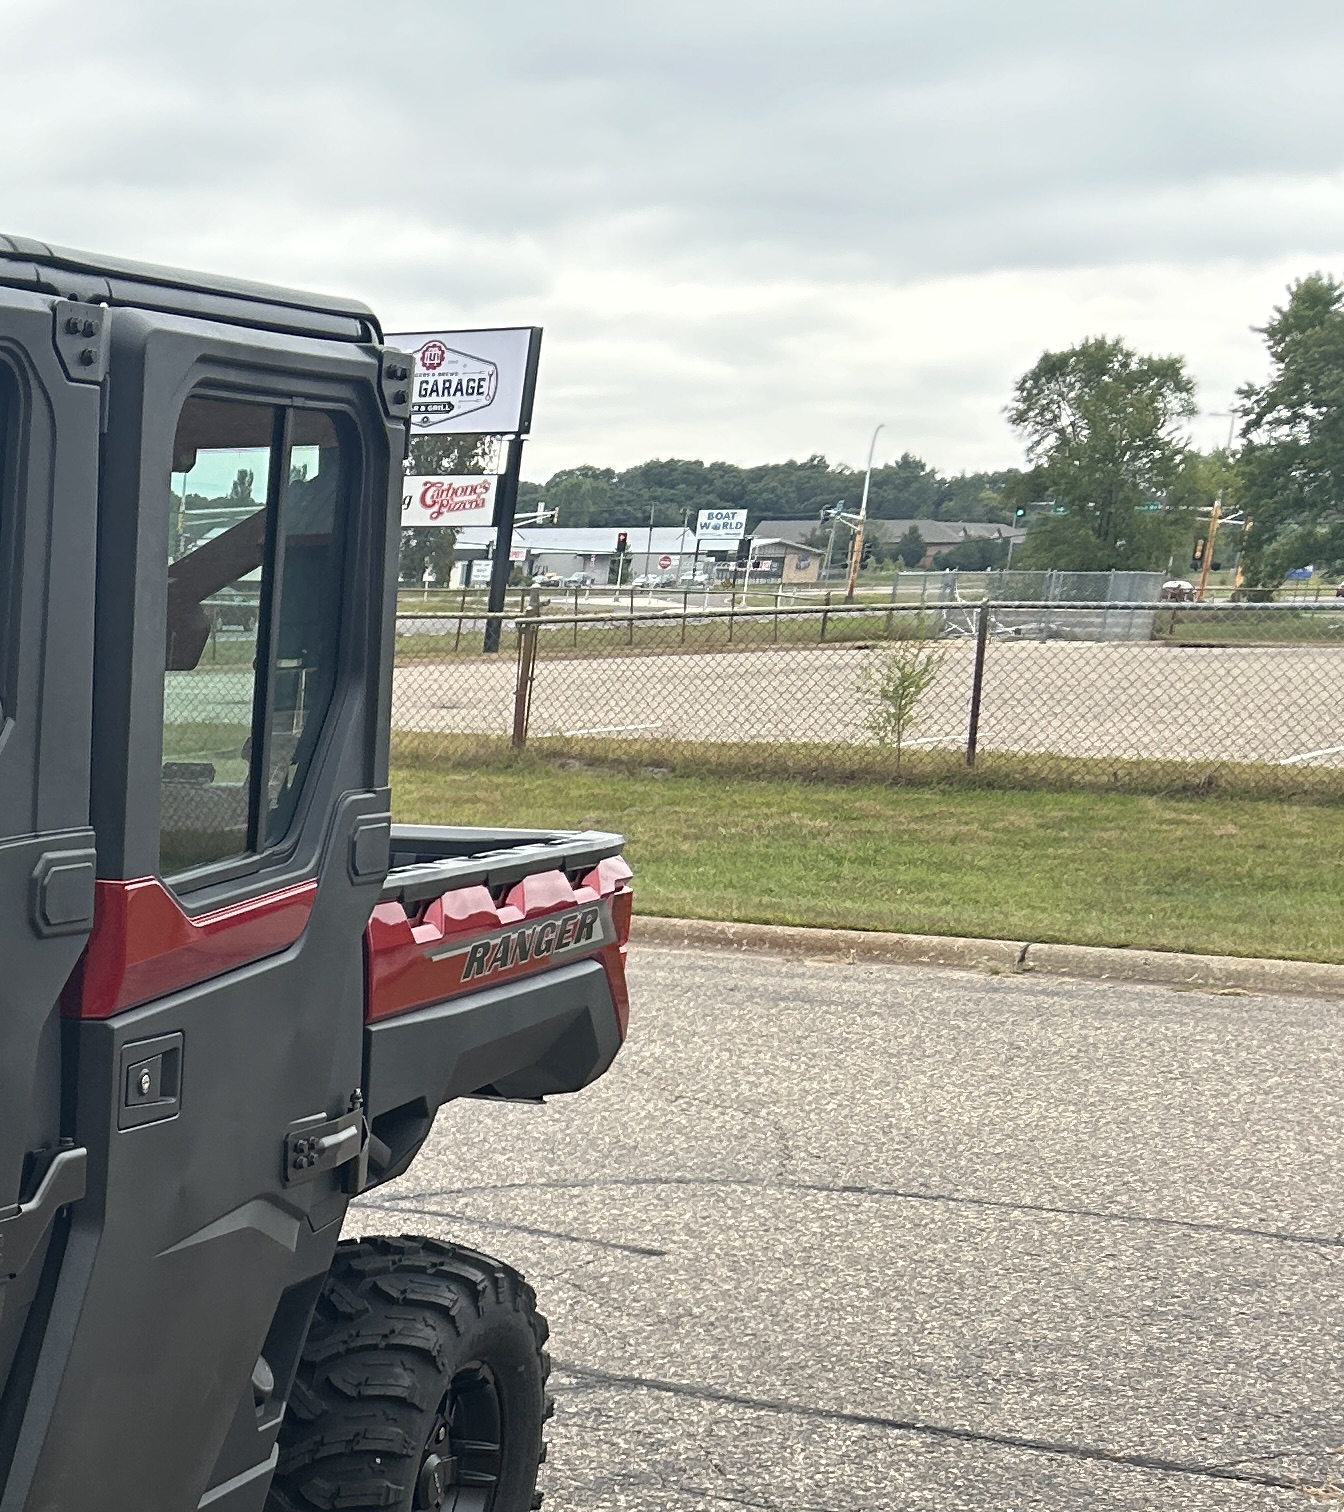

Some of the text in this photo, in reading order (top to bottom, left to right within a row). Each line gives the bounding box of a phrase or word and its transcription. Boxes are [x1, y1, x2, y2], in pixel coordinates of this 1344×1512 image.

[418, 377, 486, 398] GARAGE
[707, 511, 737, 521] BOAT
[699, 521, 744, 531] WORLD
[460, 907, 600, 983] RANGER
